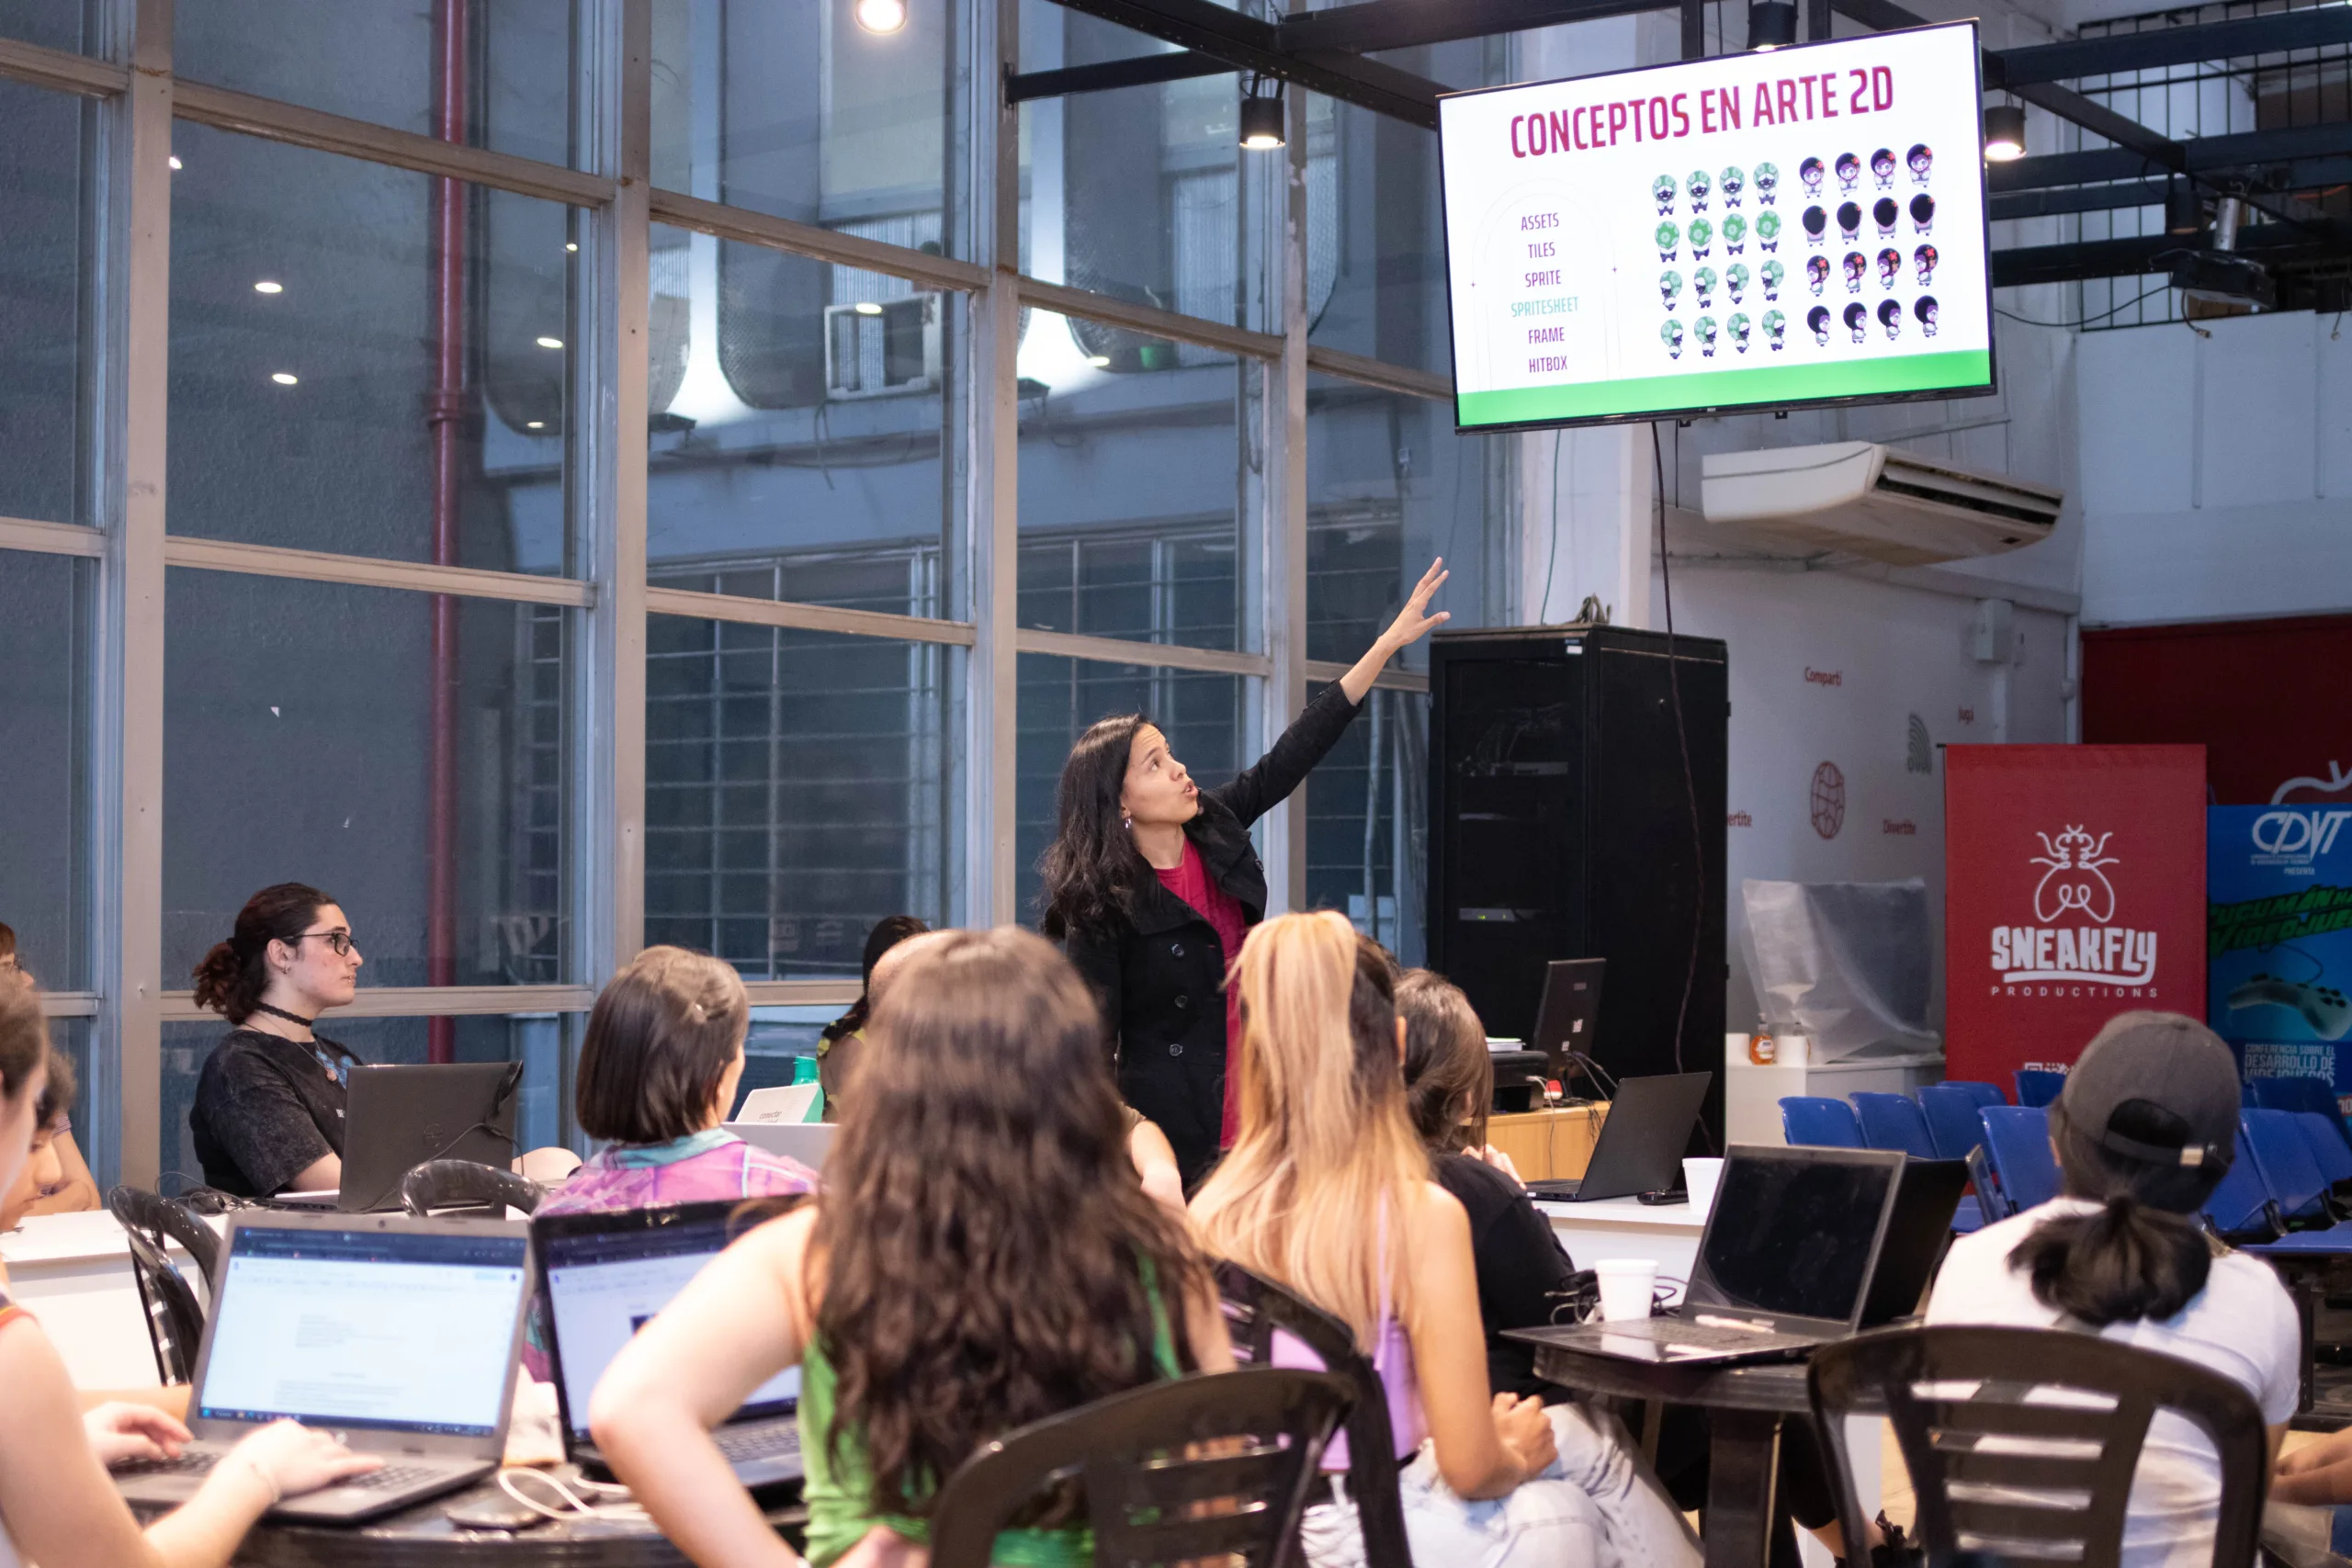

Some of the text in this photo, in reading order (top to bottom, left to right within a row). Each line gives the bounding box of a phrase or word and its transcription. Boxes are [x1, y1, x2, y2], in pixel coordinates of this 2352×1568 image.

[1510, 65, 1894, 158] CONCEPTOS EN ARTE 2D
[1521, 212, 1559, 231] ASSETS
[1527, 242, 1555, 259] TILES
[1525, 270, 1562, 288] SPRITE
[1510, 296, 1579, 318] SPRITESHEET
[1528, 327, 1566, 344] FRAME
[1529, 355, 1567, 373] HITBOX
[1991, 926, 2157, 986] SNEAKFLY
[1991, 986, 2158, 998] PRODUCTIONS
[2245, 1055, 2335, 1071] DESARROLLO DE
